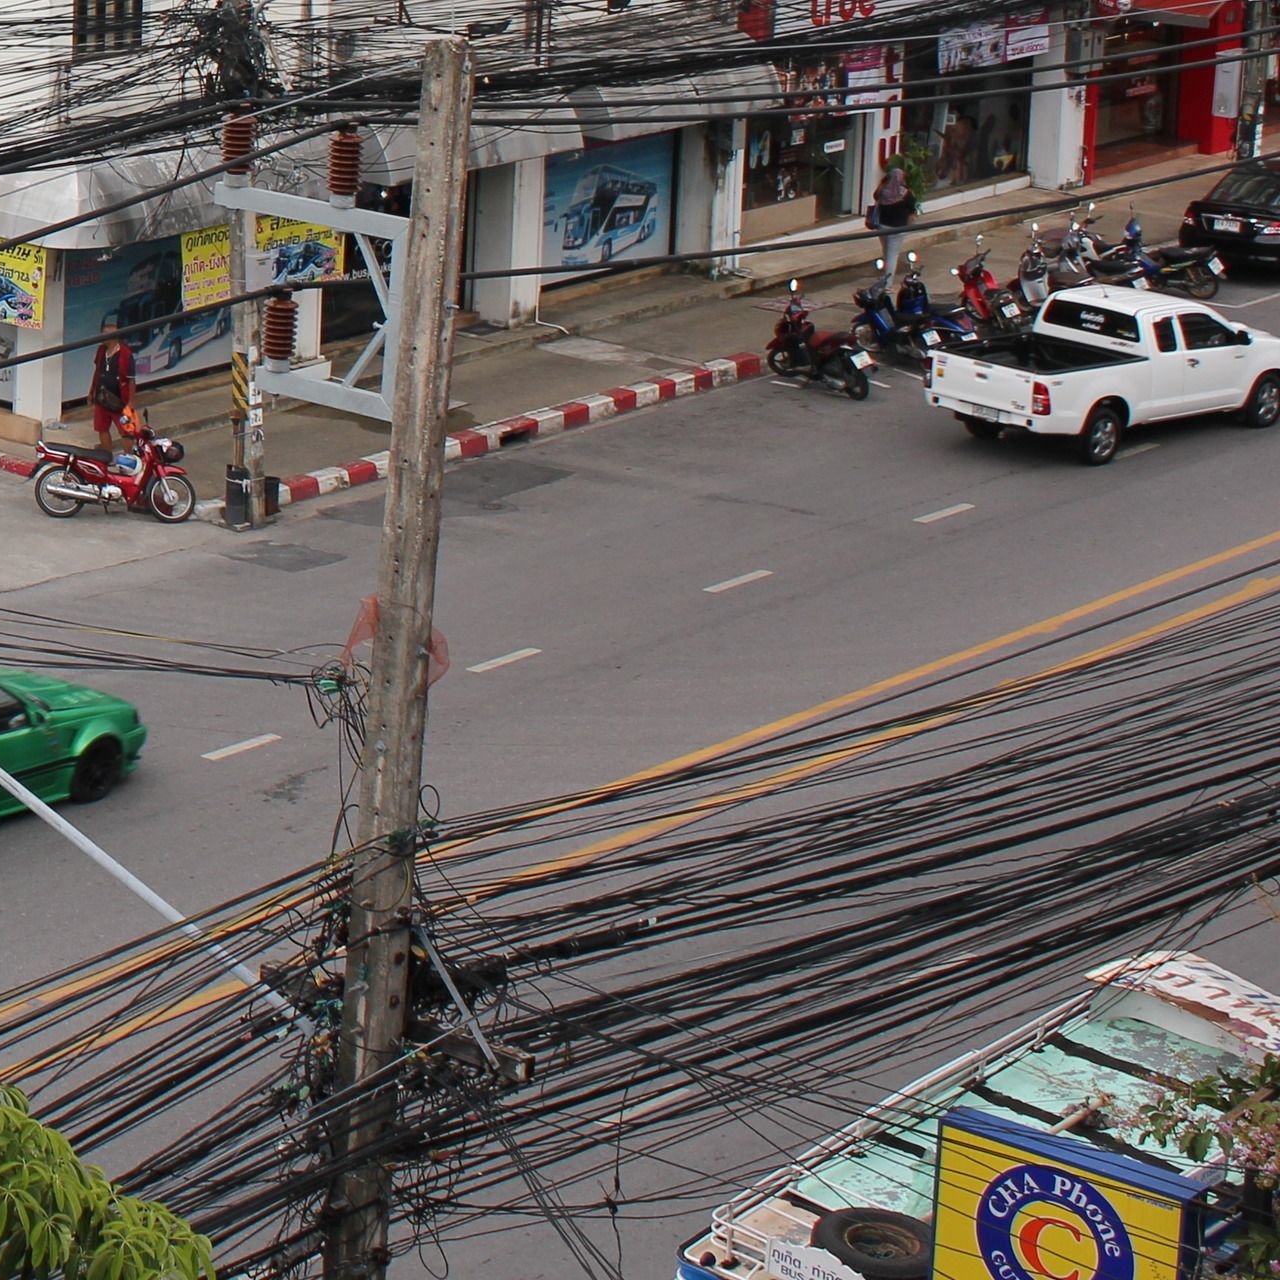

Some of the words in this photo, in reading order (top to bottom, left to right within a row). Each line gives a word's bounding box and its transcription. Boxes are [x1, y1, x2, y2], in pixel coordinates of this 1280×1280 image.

[989, 1172, 1041, 1218] CHA
[1051, 1174, 1122, 1258] Phone
[772, 1248, 801, 1269] ภูเก็ต
